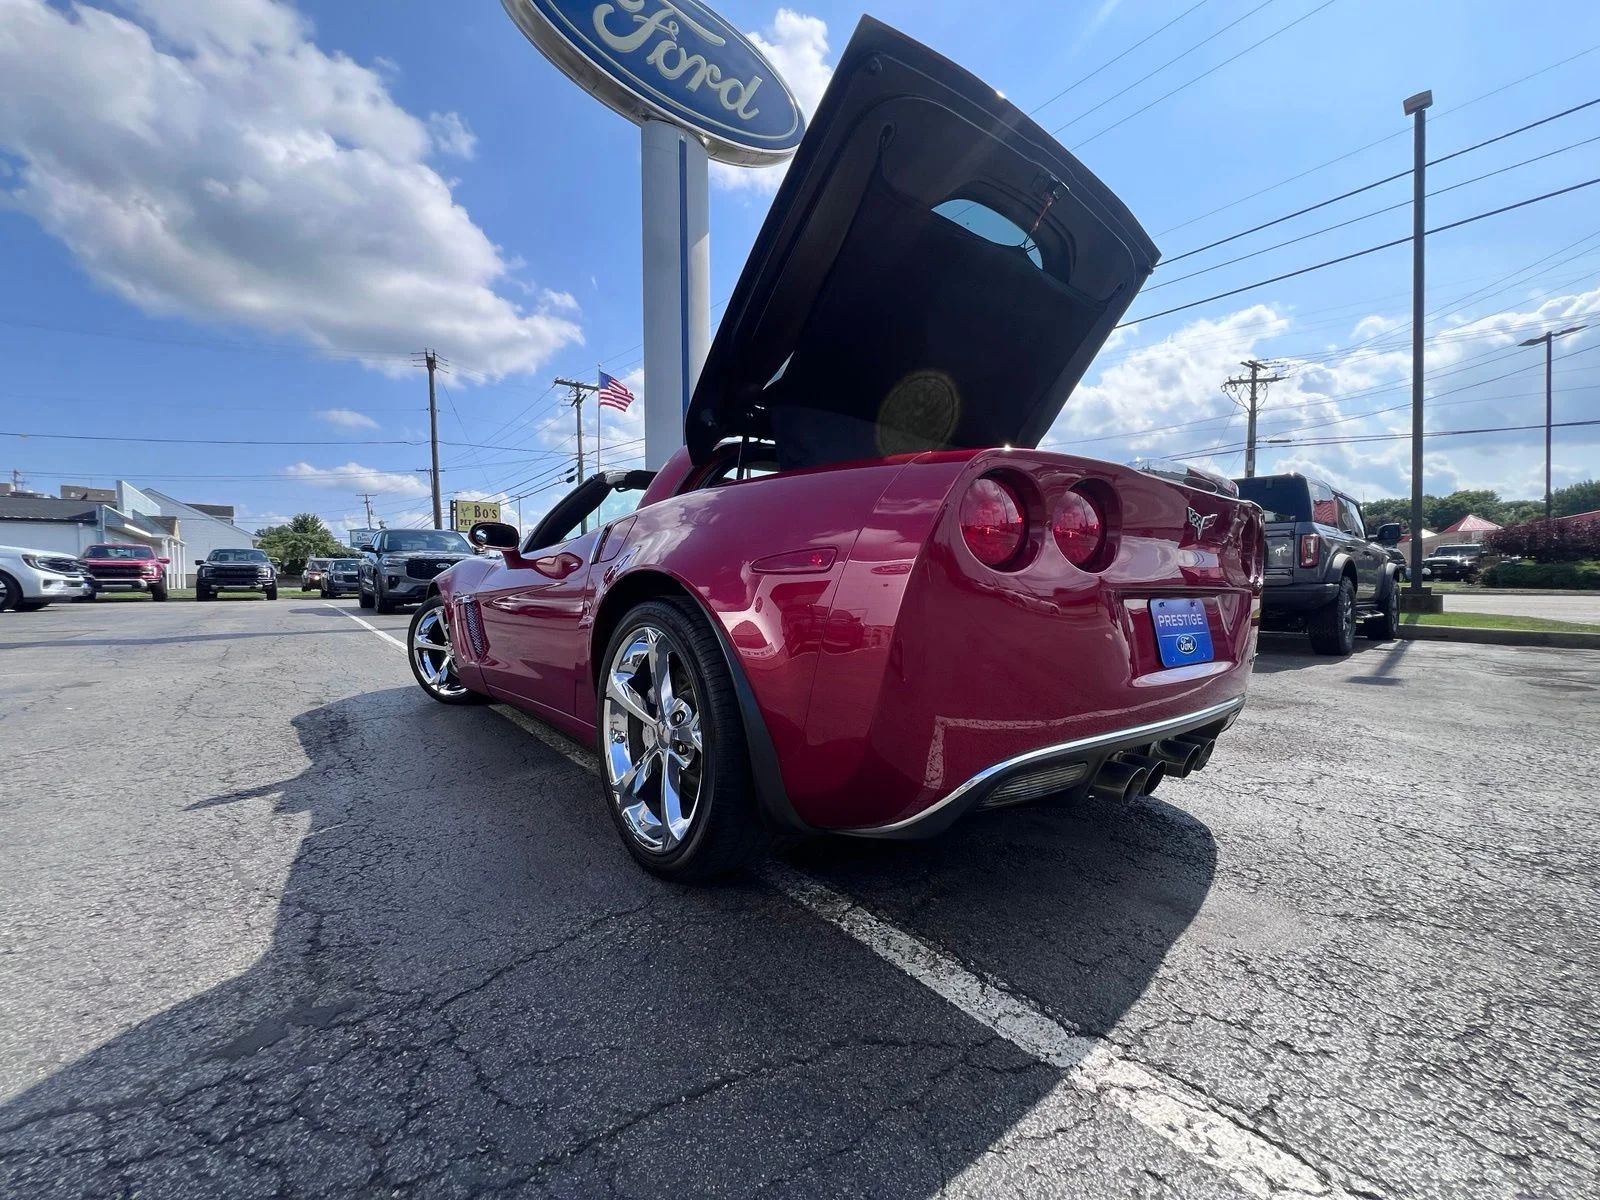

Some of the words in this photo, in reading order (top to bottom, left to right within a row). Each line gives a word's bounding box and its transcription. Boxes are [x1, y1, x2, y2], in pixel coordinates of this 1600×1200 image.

[592, 0, 763, 121] Ford
[474, 505, 498, 519] Bo's
[1157, 613, 1204, 627] PRESTIGE
[1180, 636, 1194, 651] Ford
